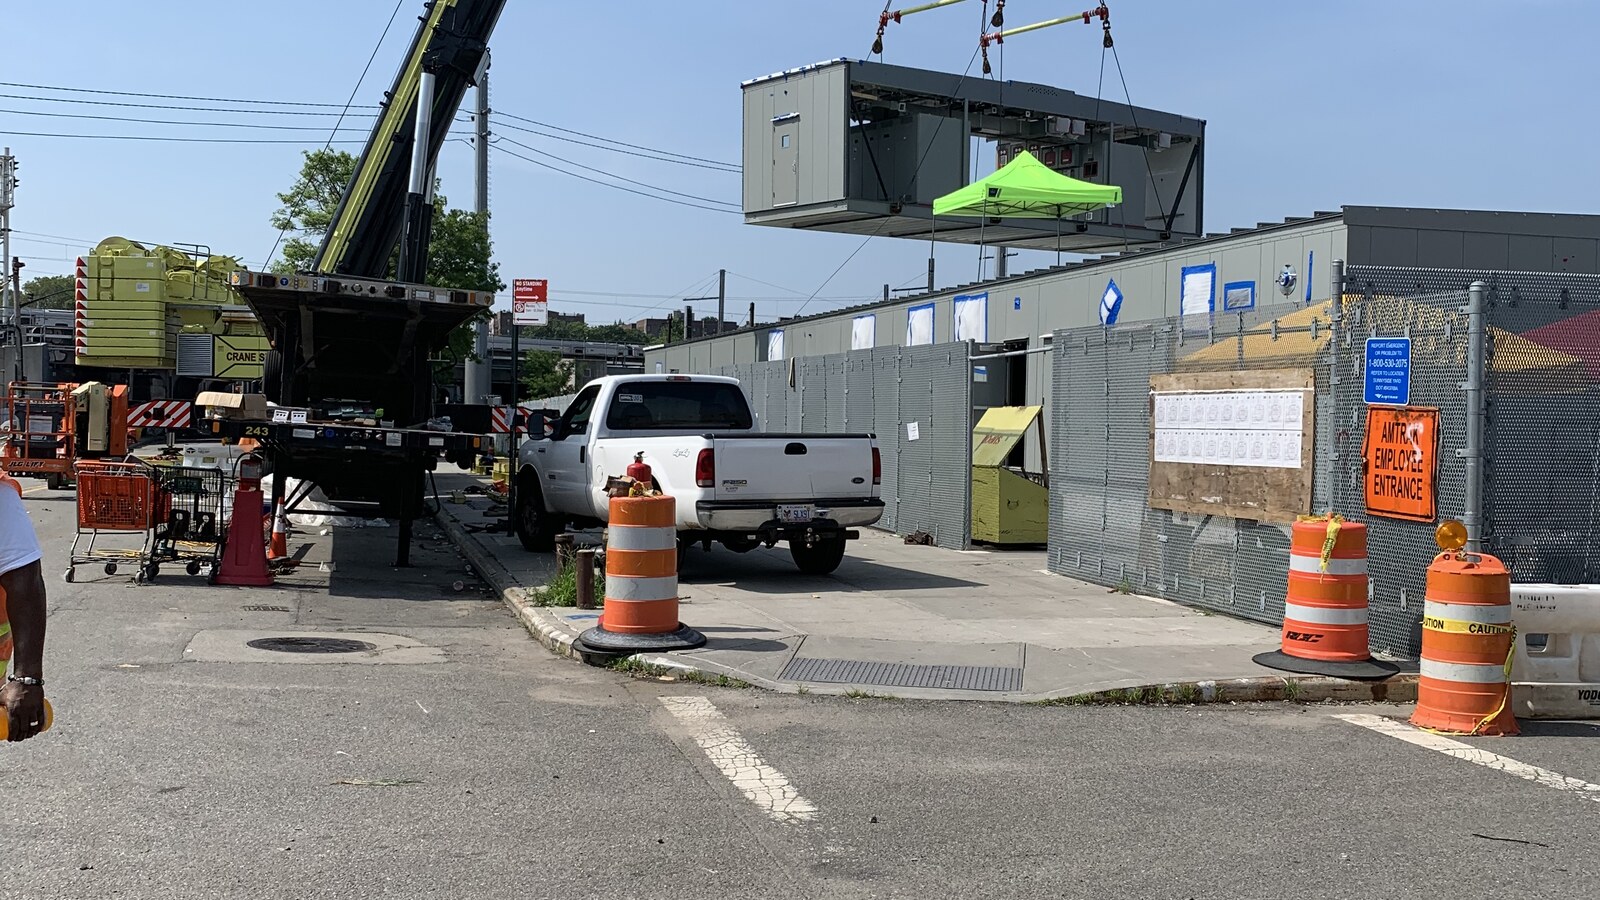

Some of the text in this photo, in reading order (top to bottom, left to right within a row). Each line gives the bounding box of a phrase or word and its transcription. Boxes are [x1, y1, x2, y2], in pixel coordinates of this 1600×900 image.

[226, 352, 267, 362] CRANE S
[1369, 359, 1407, 367] 1-800-530-2075
[245, 426, 269, 436] 243
[1375, 448, 1423, 473] EMPLOYEE
[1374, 474, 1423, 500] ENTRANCE
